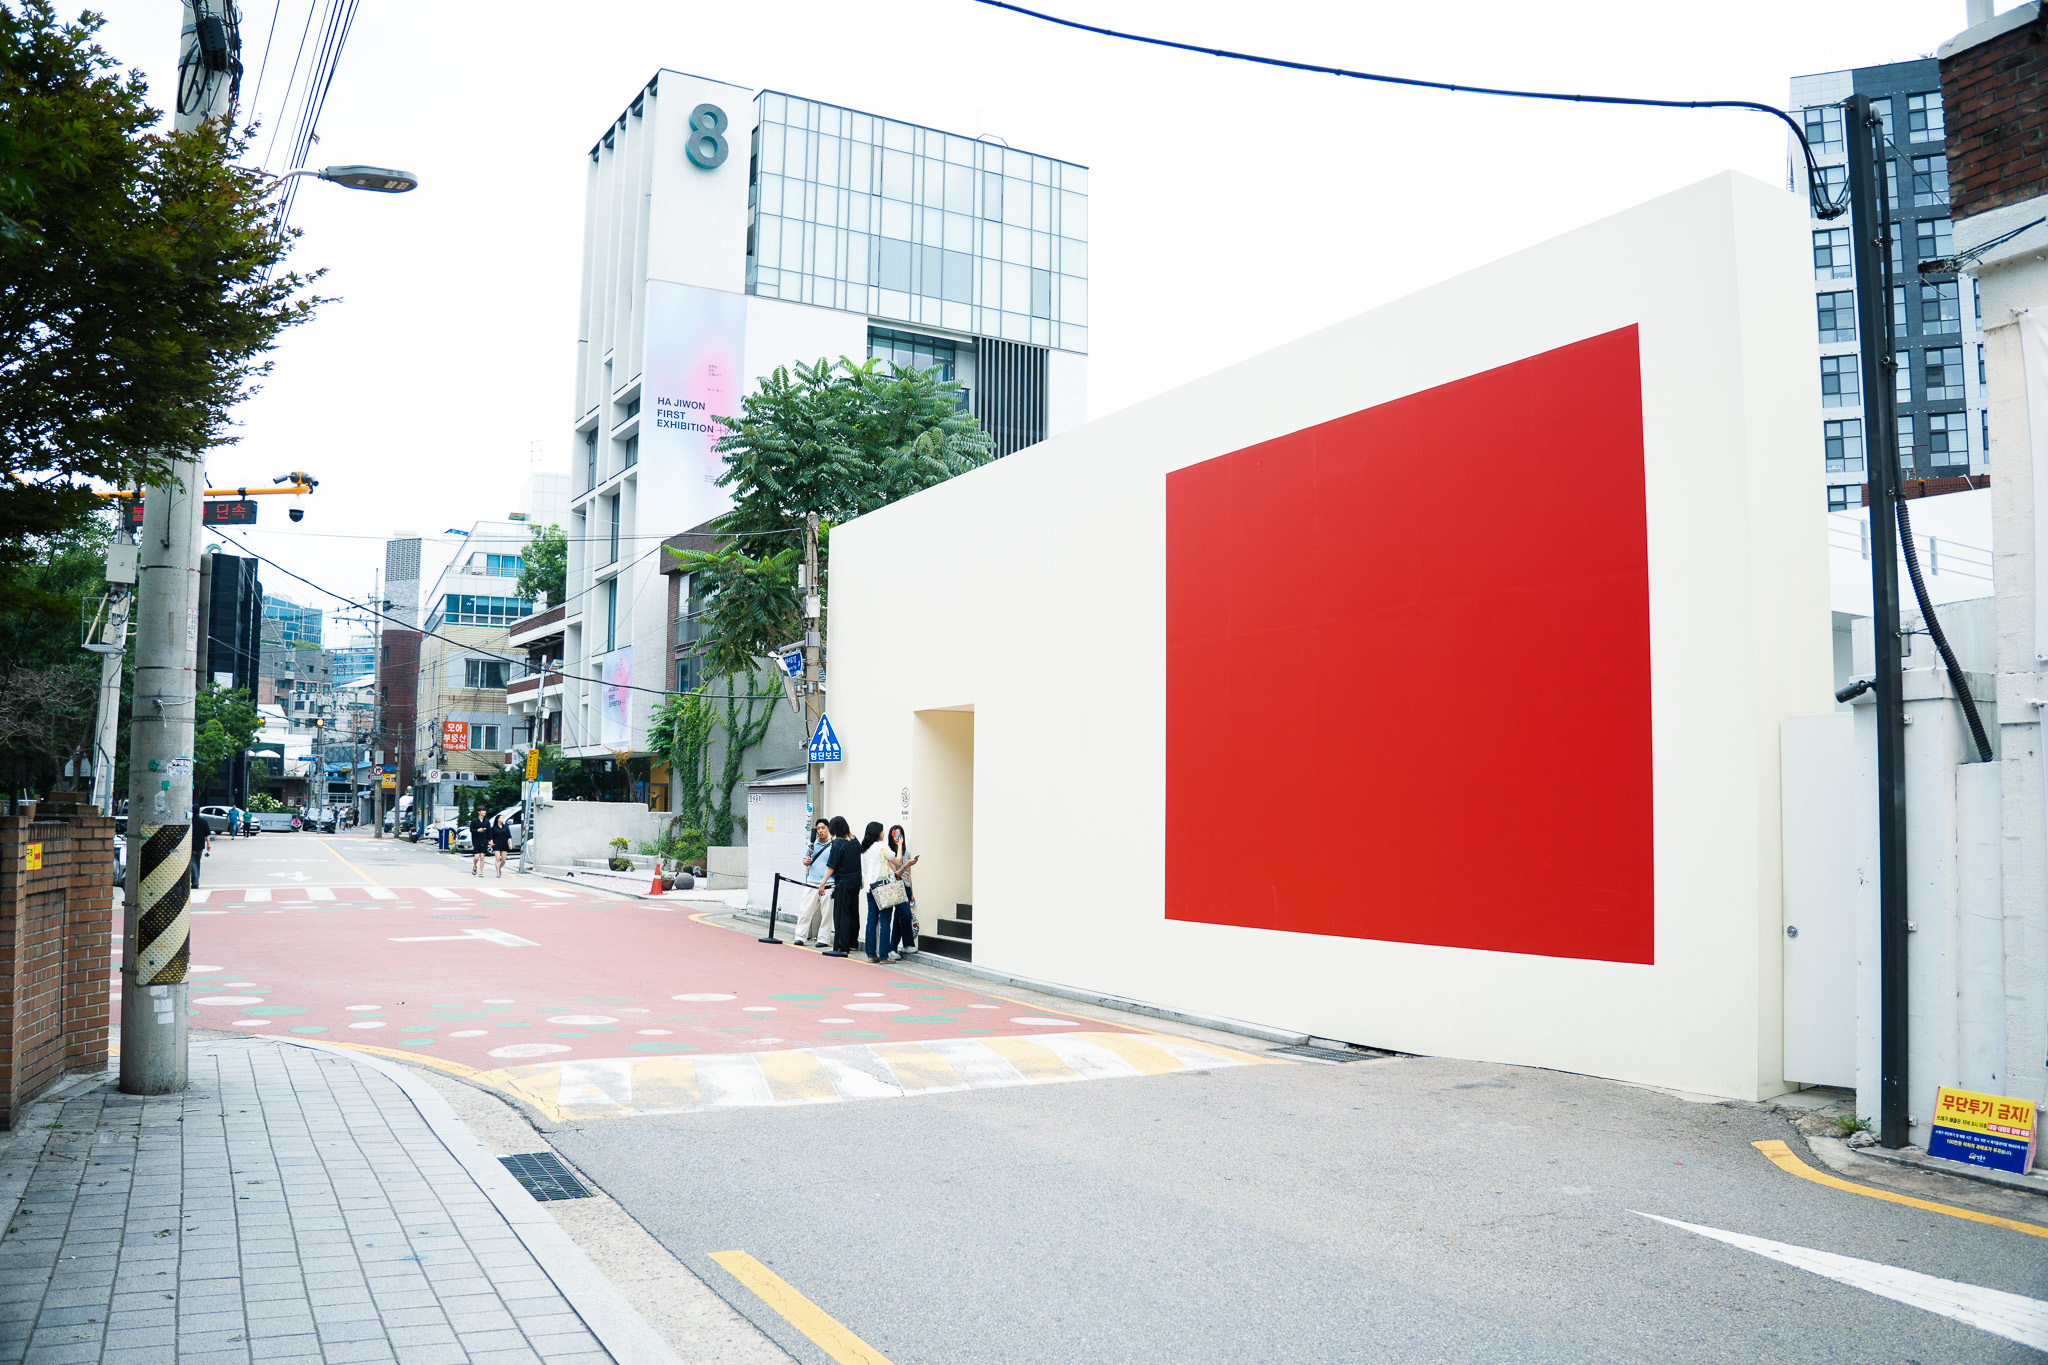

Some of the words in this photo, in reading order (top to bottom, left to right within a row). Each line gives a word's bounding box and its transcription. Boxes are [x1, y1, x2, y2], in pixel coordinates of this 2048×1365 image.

[685, 103, 729, 169] 8
[657, 397, 672, 406] HA
[673, 399, 706, 410] JIWON
[657, 409, 686, 420] FIRST
[656, 419, 714, 433] EXHIBITION
[216, 503, 246, 520] 단속
[447, 723, 463, 732] 모아
[810, 751, 840, 761] 횡단보도
[1942, 1094, 1994, 1118] 무단투기
[1997, 1103, 2030, 1123] 금지!
